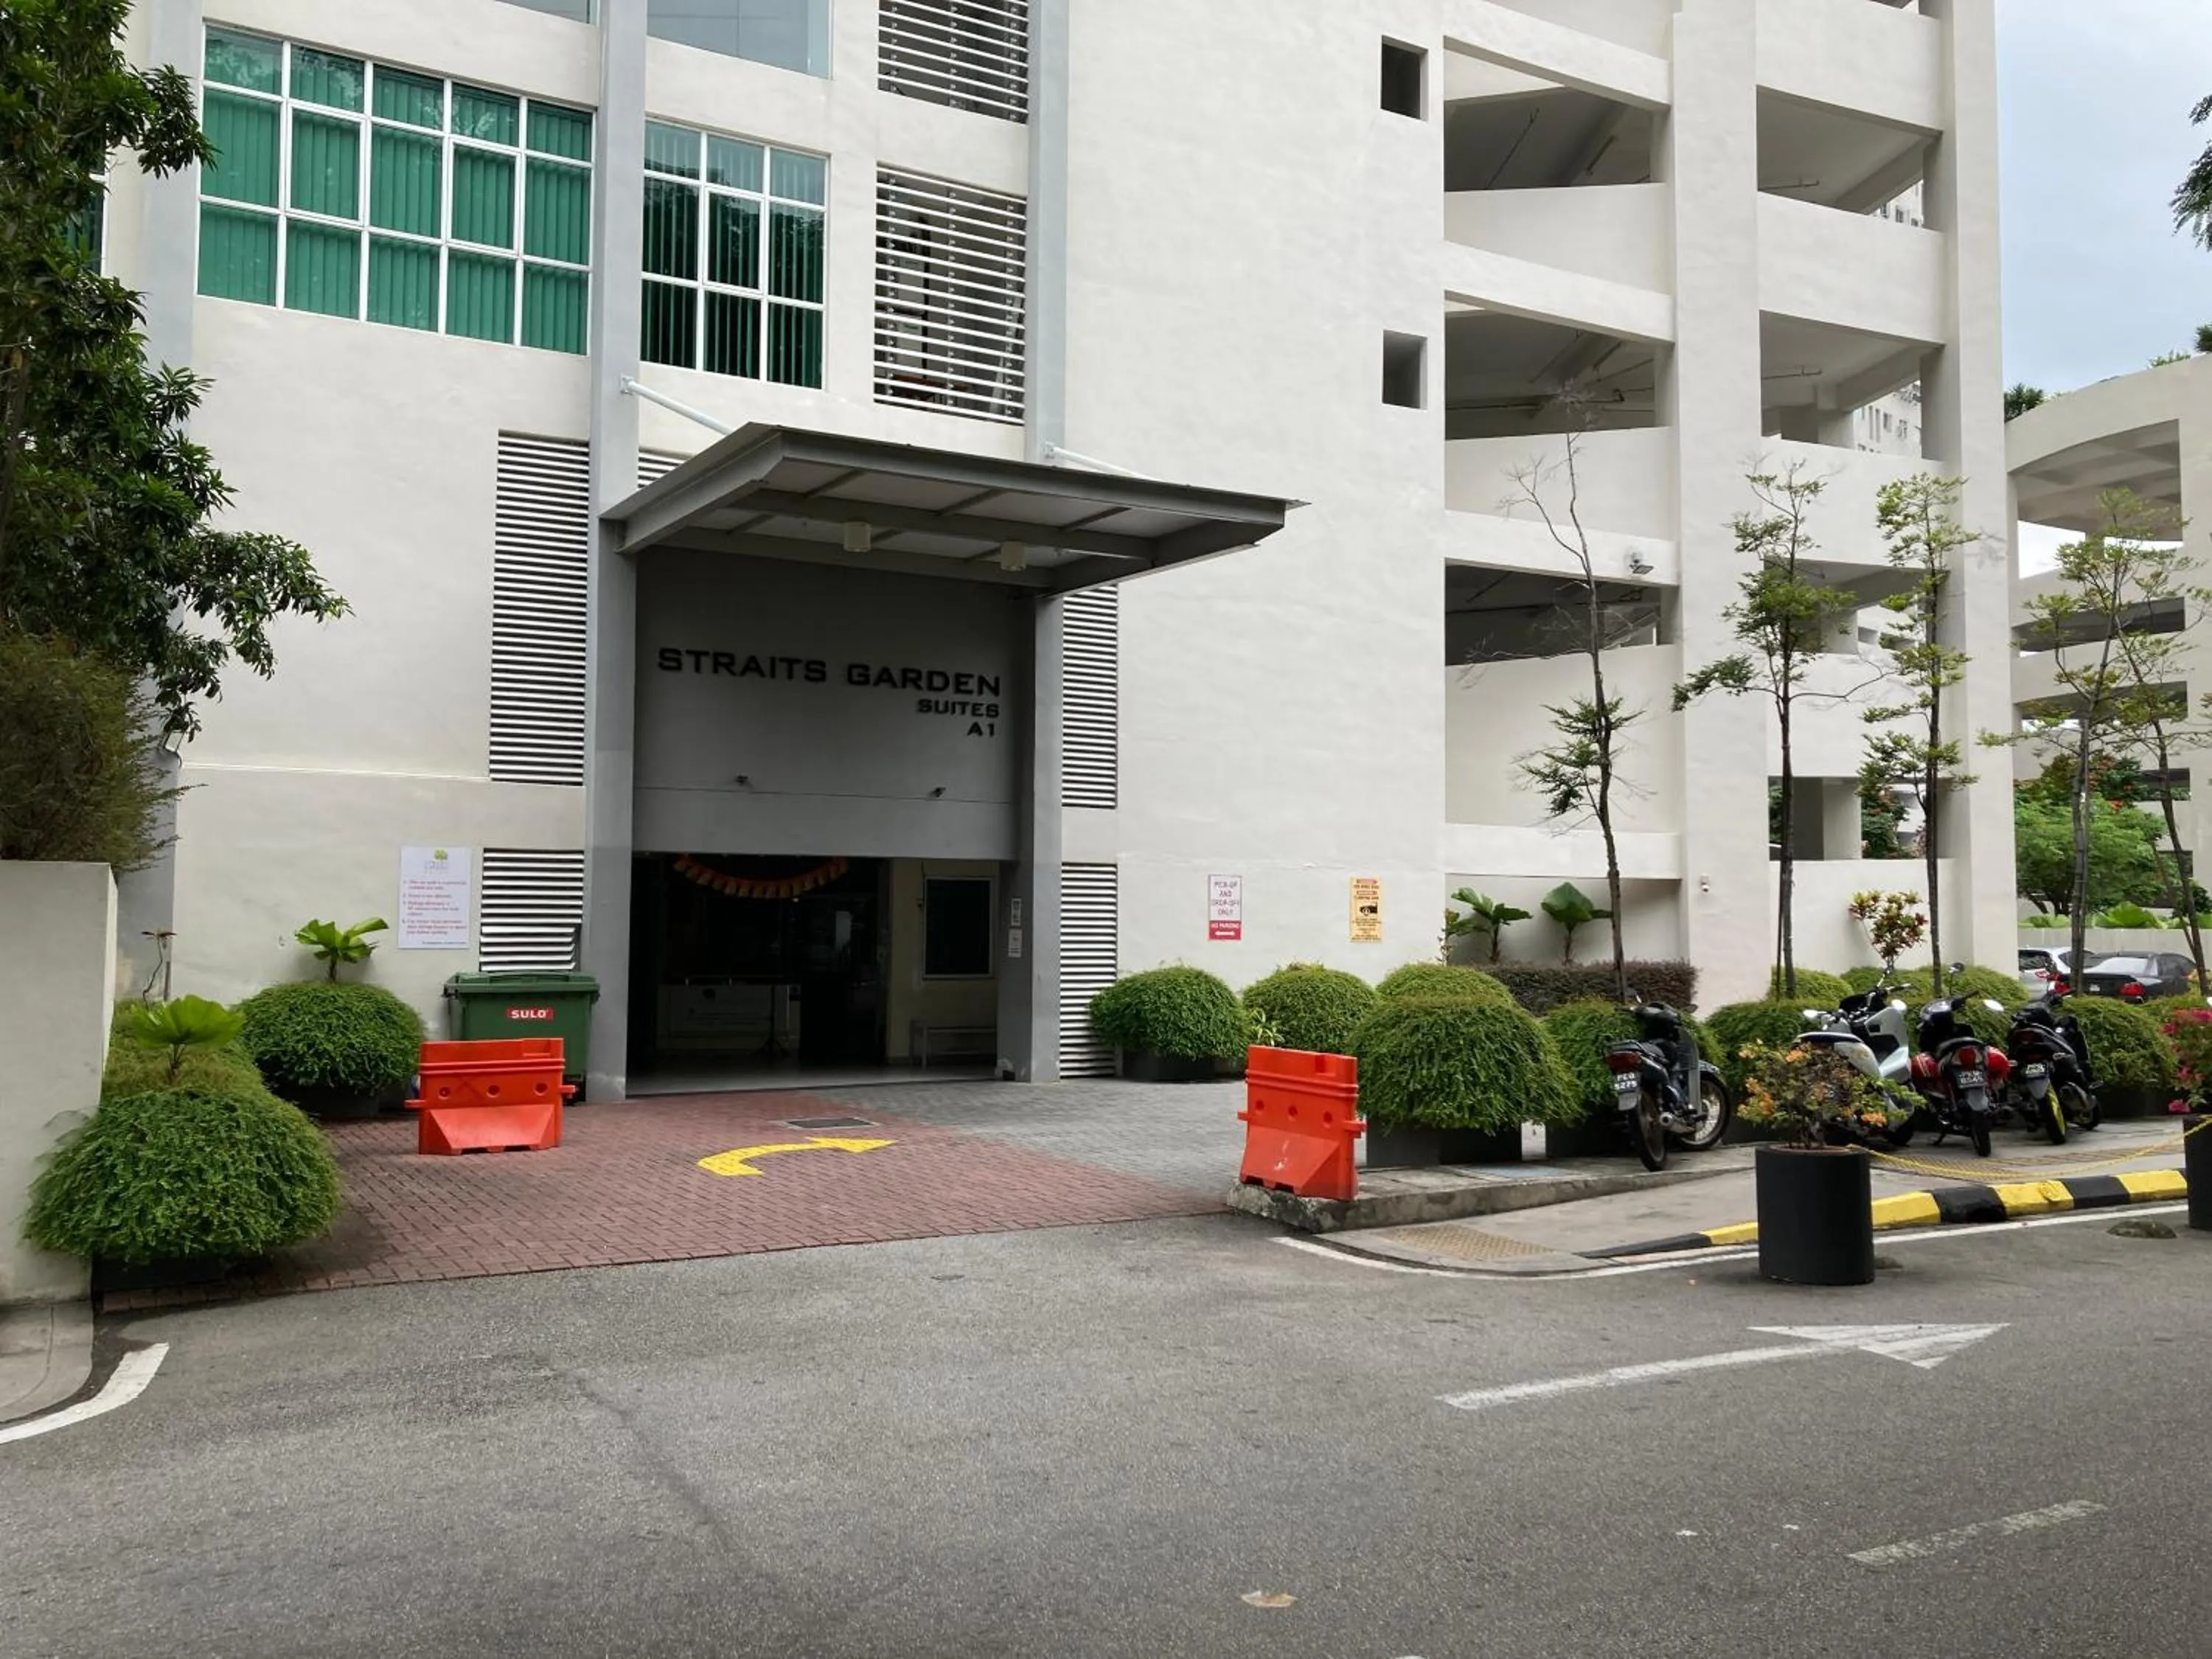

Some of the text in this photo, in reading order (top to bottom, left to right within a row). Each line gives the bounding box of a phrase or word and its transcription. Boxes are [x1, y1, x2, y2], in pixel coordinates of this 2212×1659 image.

[658, 647, 1001, 697] STRAITS GARDEN
[916, 698, 1000, 718] SUITES
[967, 720, 995, 737] A1
[511, 1009, 546, 1019] SULO
